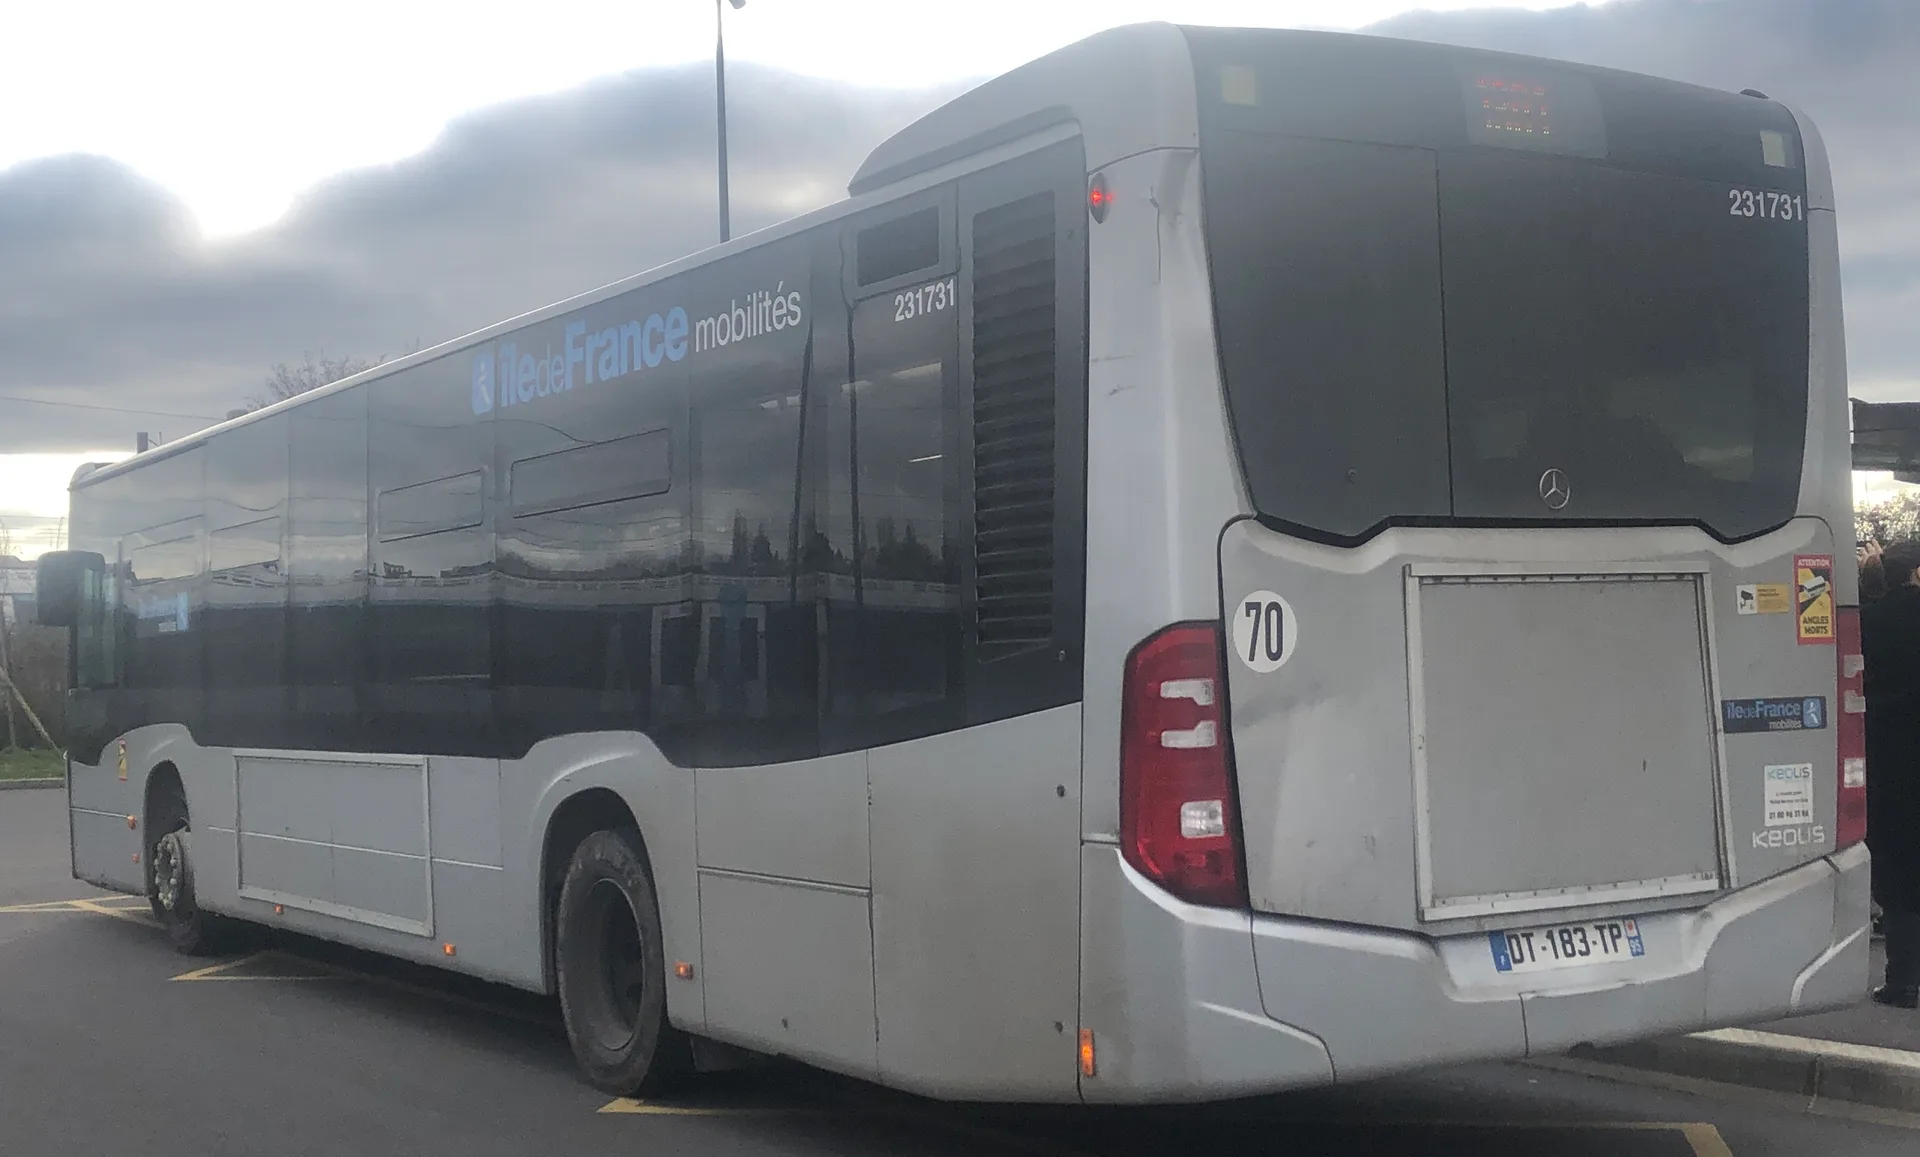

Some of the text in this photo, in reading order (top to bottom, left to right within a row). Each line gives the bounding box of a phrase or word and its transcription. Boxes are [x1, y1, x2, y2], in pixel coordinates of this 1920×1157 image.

[1729, 189, 1802, 221] 231731
[694, 281, 801, 353] mobilités
[894, 278, 954, 322] 231731
[1245, 601, 1284, 662] 70
[1802, 615, 1829, 625] ANGLES
[1804, 625, 1828, 635] MORTS
[1506, 923, 1622, 965] DT-183-TP
[1629, 938, 1642, 954] 95
